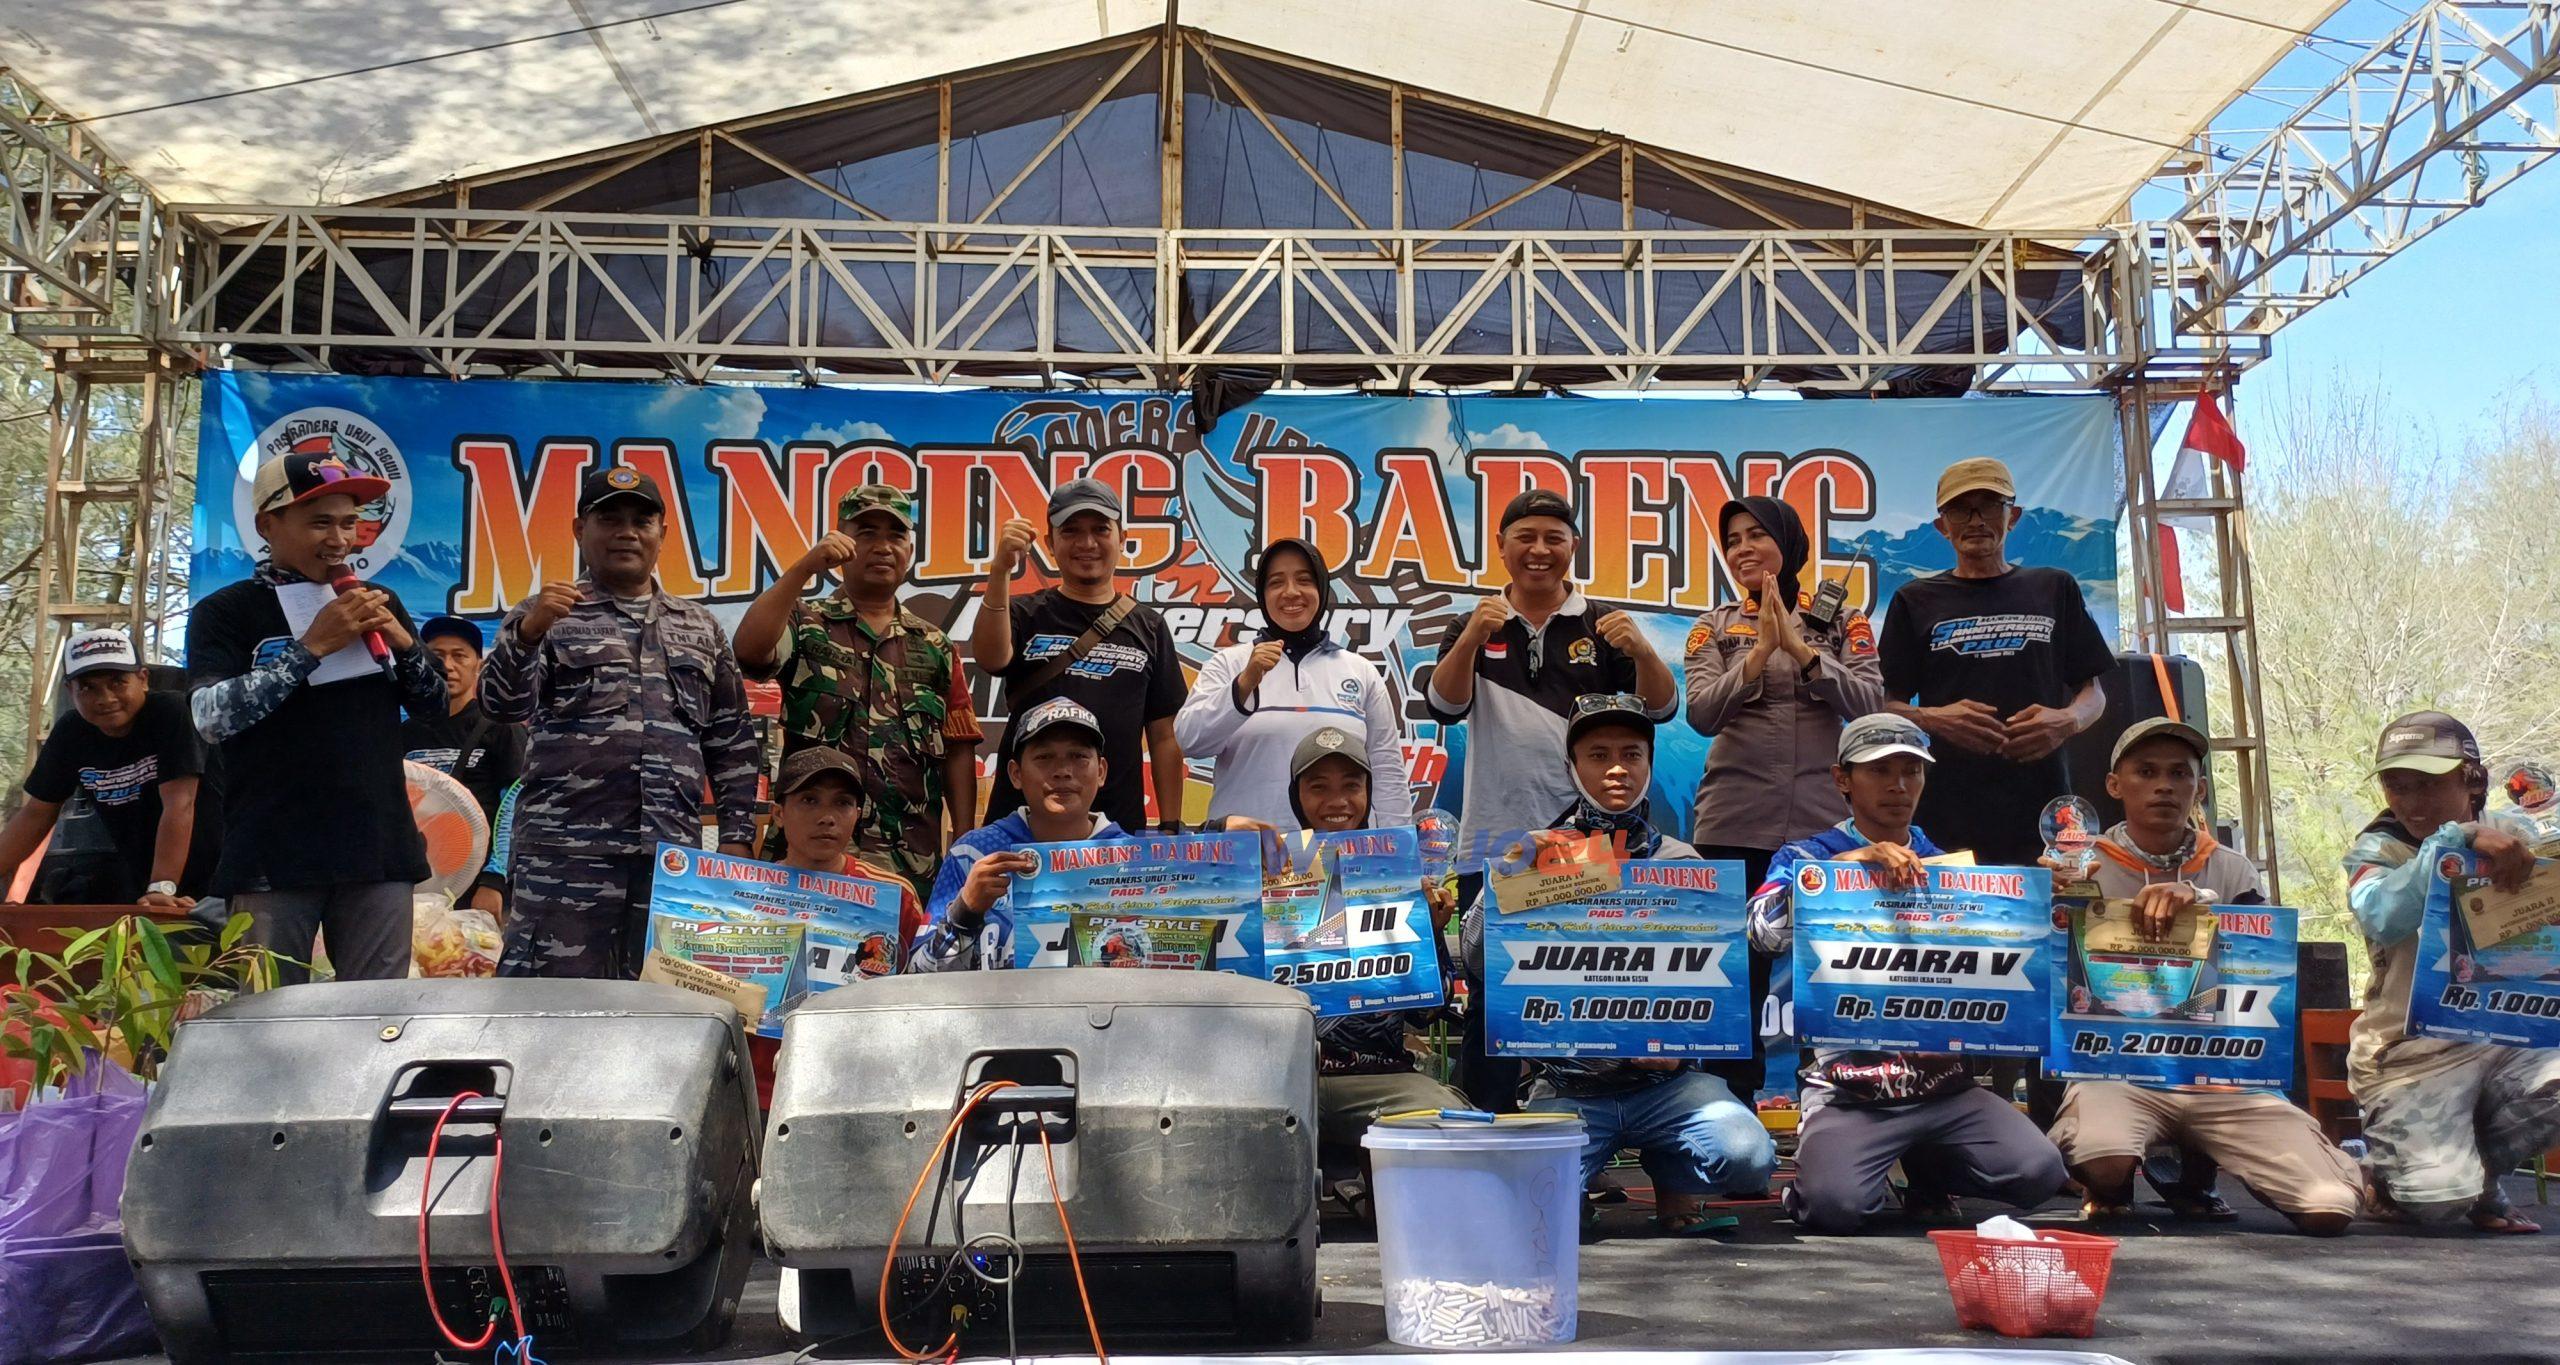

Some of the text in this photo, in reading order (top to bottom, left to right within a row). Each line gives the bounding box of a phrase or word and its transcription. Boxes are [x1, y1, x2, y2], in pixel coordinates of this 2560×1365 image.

[345, 423, 377, 446] URUT
[1961, 638, 2025, 652] PAUS
[1047, 706, 1098, 726] RAFIKA
[2388, 733, 2425, 743] Supreme
[1049, 840, 1235, 873] MANCING BARENG
[696, 855, 879, 907] MANCING BARENG
[1088, 872, 1196, 886] PASIRANERS URUT SEWU
[1539, 873, 1572, 887] JUARA
[1631, 866, 1718, 890] BARENG
[1938, 870, 2025, 898] BARENG
[1110, 886, 1145, 897] PAUS
[1624, 897, 1648, 906] URUT
[1651, 897, 1678, 906] SEWU
[753, 904, 788, 916] PAUS
[788, 900, 811, 910] URUT
[813, 903, 839, 914] SEWU
[1588, 909, 1624, 918] PAUS
[1895, 912, 1931, 922] PAUS
[1932, 901, 1955, 911] URUT
[1958, 902, 1984, 912] SEWU
[2512, 900, 2545, 918] JUARA
[1359, 907, 1398, 933] III
[2218, 912, 2272, 936] RENG
[1518, 945, 1713, 972] JUARA IV
[1830, 946, 2021, 977] JUARA V
[1273, 954, 1411, 987] 2.500.000
[1584, 975, 1614, 983] KATEGORI
[2442, 985, 2480, 1010] Rp.
[1523, 998, 1713, 1023] Rp. 1.000.000
[1836, 996, 2007, 1022] Rp. 500.000
[2075, 1031, 2264, 1058] Rp. 2.000.000
